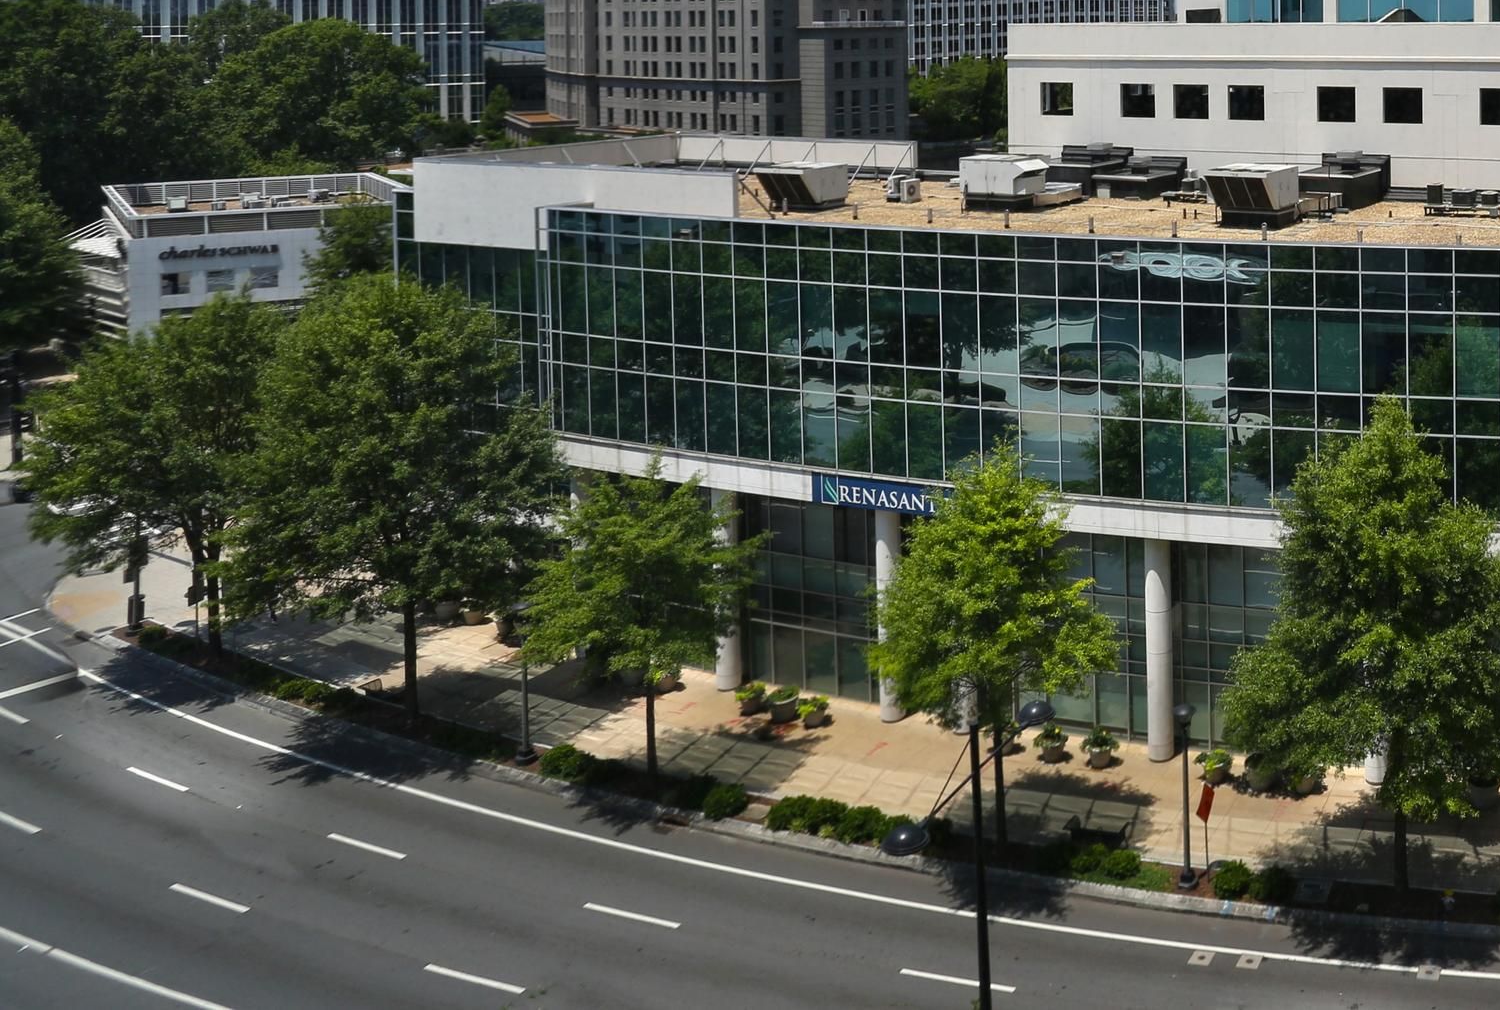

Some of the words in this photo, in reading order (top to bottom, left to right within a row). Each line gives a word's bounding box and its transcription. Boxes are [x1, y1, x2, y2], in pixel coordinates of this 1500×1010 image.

[158, 244, 217, 261] charles
[218, 244, 280, 258] SCHWAB
[839, 485, 936, 513] RENASANT
